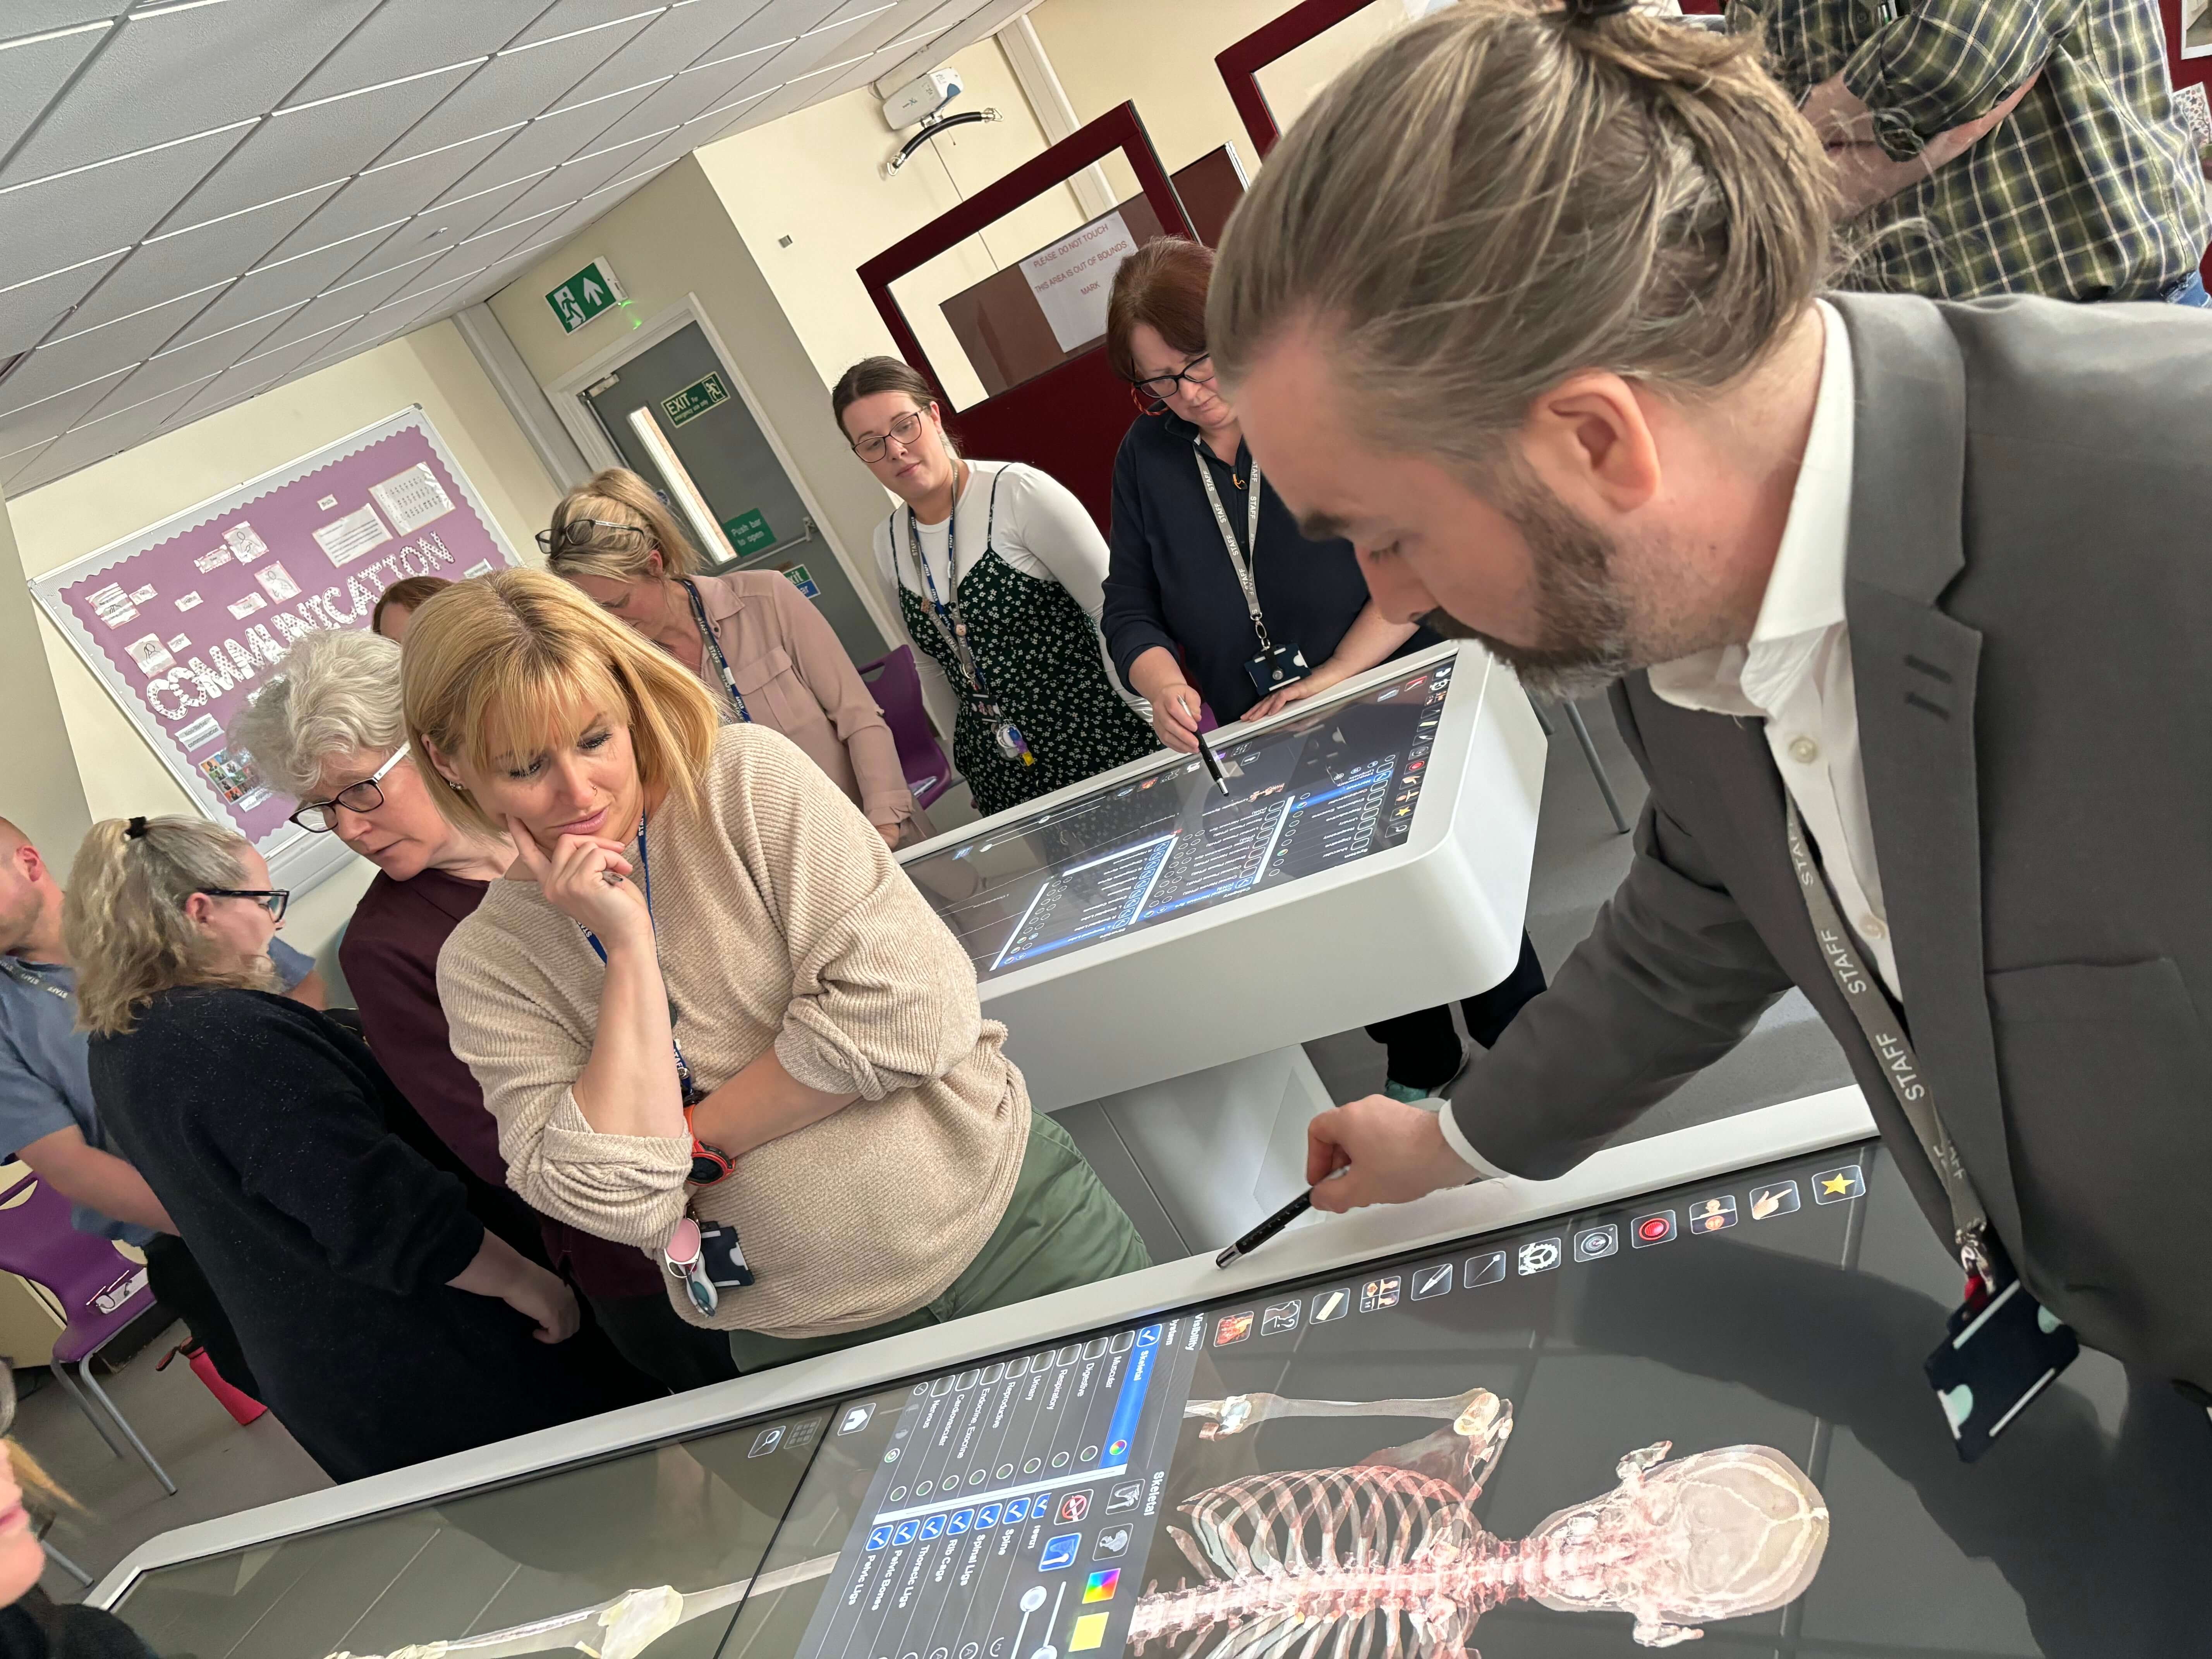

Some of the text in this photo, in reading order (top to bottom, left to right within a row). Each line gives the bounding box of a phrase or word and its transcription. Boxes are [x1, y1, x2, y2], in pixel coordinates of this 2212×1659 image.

[1033, 223, 1108, 268] PLEASE DO NOT TOUCH
[1034, 282, 1049, 293] THIS
[1049, 273, 1066, 287] AREA
[1073, 261, 1087, 273] OUT
[1087, 256, 1097, 266] OF
[1097, 240, 1127, 261] BOUNDS
[1080, 280, 1100, 295] MARK
[666, 393, 690, 416] EXIT
[1203, 471, 1214, 491] STAFF
[1214, 503, 1226, 523] STAFF
[731, 519, 761, 537] Push bar
[747, 531, 764, 542] open
[1226, 535, 1238, 556] STAFF
[787, 570, 804, 584] xit
[1239, 568, 1248, 590] STAFF
[146, 531, 455, 720] COMMUNICATION
[697, 617, 709, 635] STAFF
[945, 635, 958, 651] STAFF
[708, 646, 720, 663] STAFF
[735, 696, 744, 709] STAFF
[1346, 779, 1371, 790] Nervous
[1328, 788, 1368, 805] Cardiovascular
[1311, 808, 1335, 818] Exocrine
[1326, 807, 1362, 821] Reproductive
[1338, 817, 1358, 826] Urinary
[1239, 826, 1259, 836] Lumbar
[1323, 826, 1355, 840] Respiratory
[1228, 845, 1250, 855] Thoracic
[1325, 836, 1352, 848] Digestive
[1210, 853, 1228, 861] Nerves
[1322, 847, 1348, 858] Muscular
[1344, 848, 1368, 858] System
[1789, 823, 1813, 886] STA
[1207, 862, 1224, 870] Plexus
[1199, 881, 1218, 890] Nerves
[1203, 872, 1220, 880] Plexus
[1218, 875, 1237, 884] Cranial
[1186, 893, 1211, 904] Nervous
[1223, 887, 1251, 898] Category
[1099, 927, 1126, 938] Structure
[1820, 929, 1866, 994] STAFF
[47, 986, 68, 999] STAFF
[1876, 1033, 1925, 1101] STAFF
[1185, 1313, 1204, 1351] Visibility
[1106, 1356, 1122, 1388] Muscular
[1133, 1350, 1149, 1381] Skeletal
[1025, 1375, 1042, 1400] Urinary
[1077, 1362, 1095, 1397] Digestive
[1046, 1369, 1068, 1410] Respiratory
[992, 1381, 1016, 1428] Reproductive
[923, 1400, 941, 1429] Nervous
[938, 1394, 965, 1446] Cardiovascular
[957, 1388, 990, 1458] Endocrine, Exocrine
[1144, 1471, 1164, 1516] Skeletal
[998, 1528, 1014, 1555] Spine
[935, 1539, 958, 1582] Rib Cage
[960, 1534, 986, 1586] Spinal Ligs
[848, 1554, 876, 1605] Pelvic Ligs
[871, 1549, 903, 1611] Pelvic Bones
[898, 1544, 930, 1608] Thoracic Ligs
